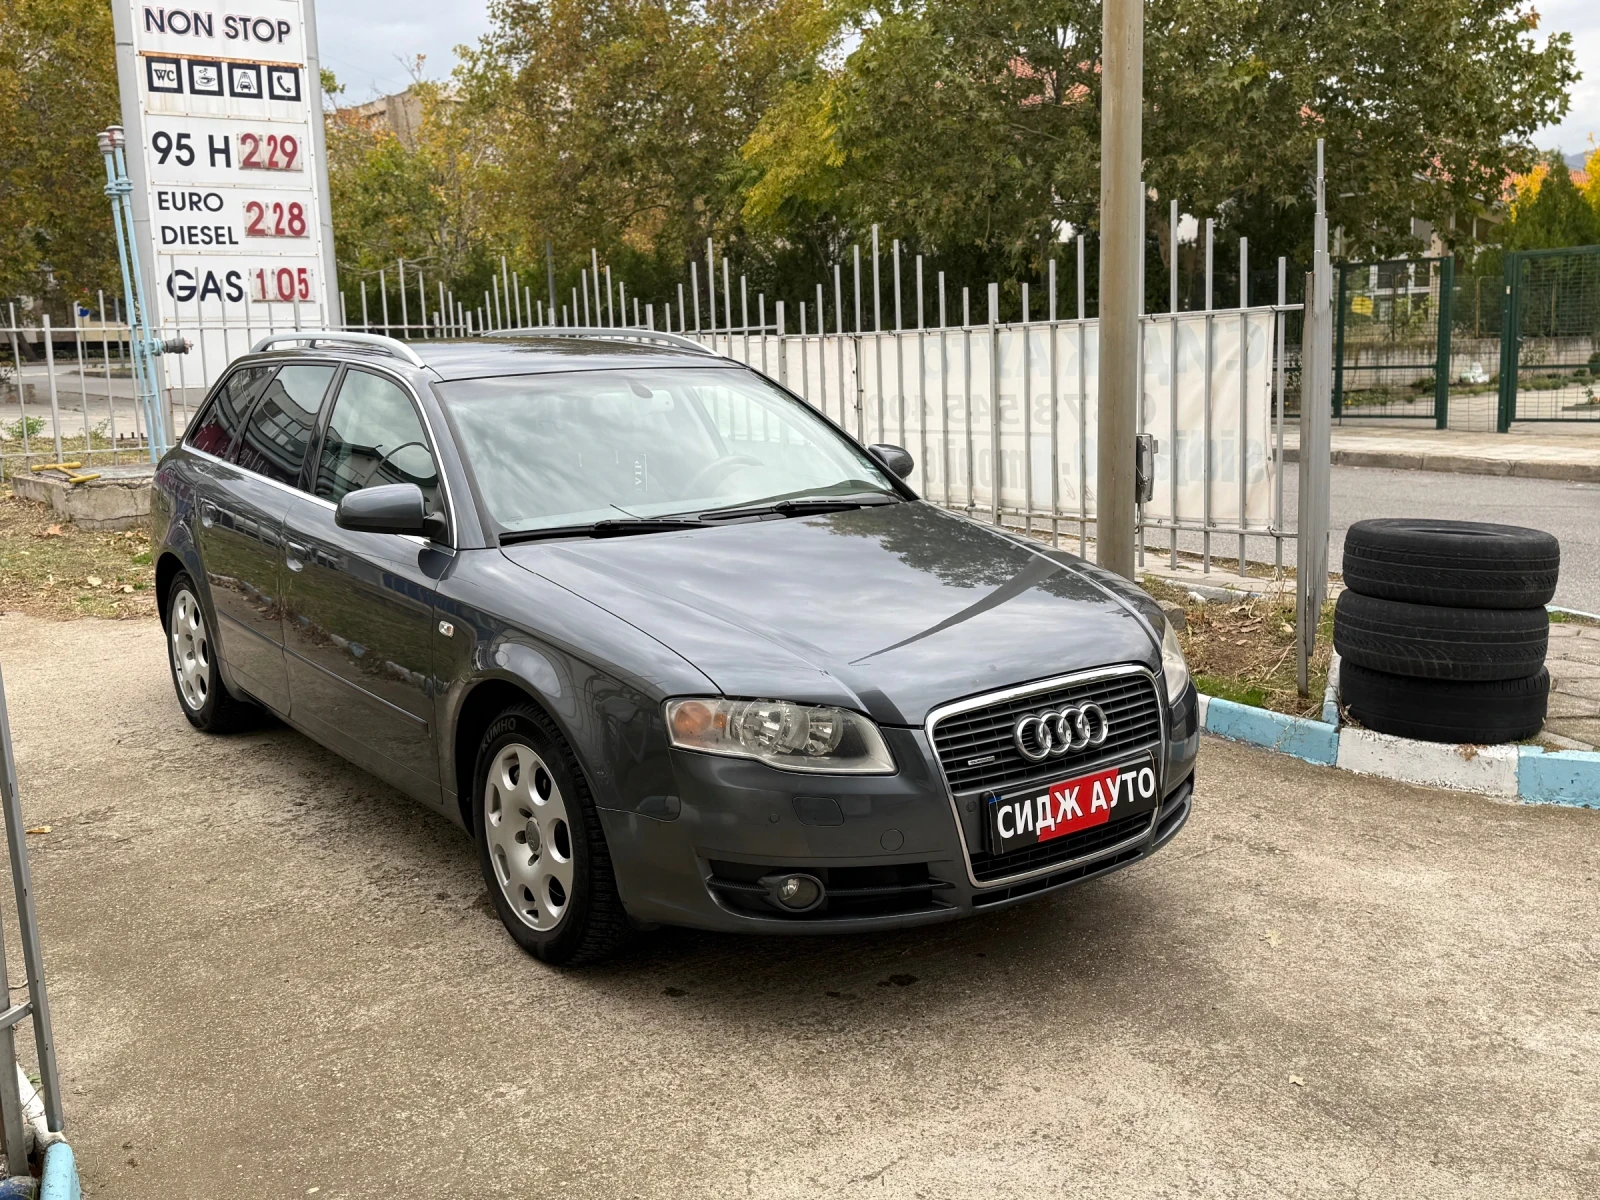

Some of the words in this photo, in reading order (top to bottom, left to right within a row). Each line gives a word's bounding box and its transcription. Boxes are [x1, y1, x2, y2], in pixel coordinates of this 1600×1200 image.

[145, 8, 213, 37] NON
[225, 16, 291, 43] STOP
[153, 68, 176, 83] WC
[152, 131, 195, 166] 95
[209, 134, 232, 168] H
[240, 133, 298, 169] 229
[158, 191, 223, 212] EURO
[245, 200, 306, 236] 228
[161, 226, 239, 245] DIESEL
[167, 269, 243, 302] GAS
[255, 268, 309, 301] 105
[634, 460, 643, 485] VIP
[481, 717, 517, 752] KUMHO
[996, 786, 1084, 839] СИДЖ
[1090, 766, 1155, 814] АУТО
